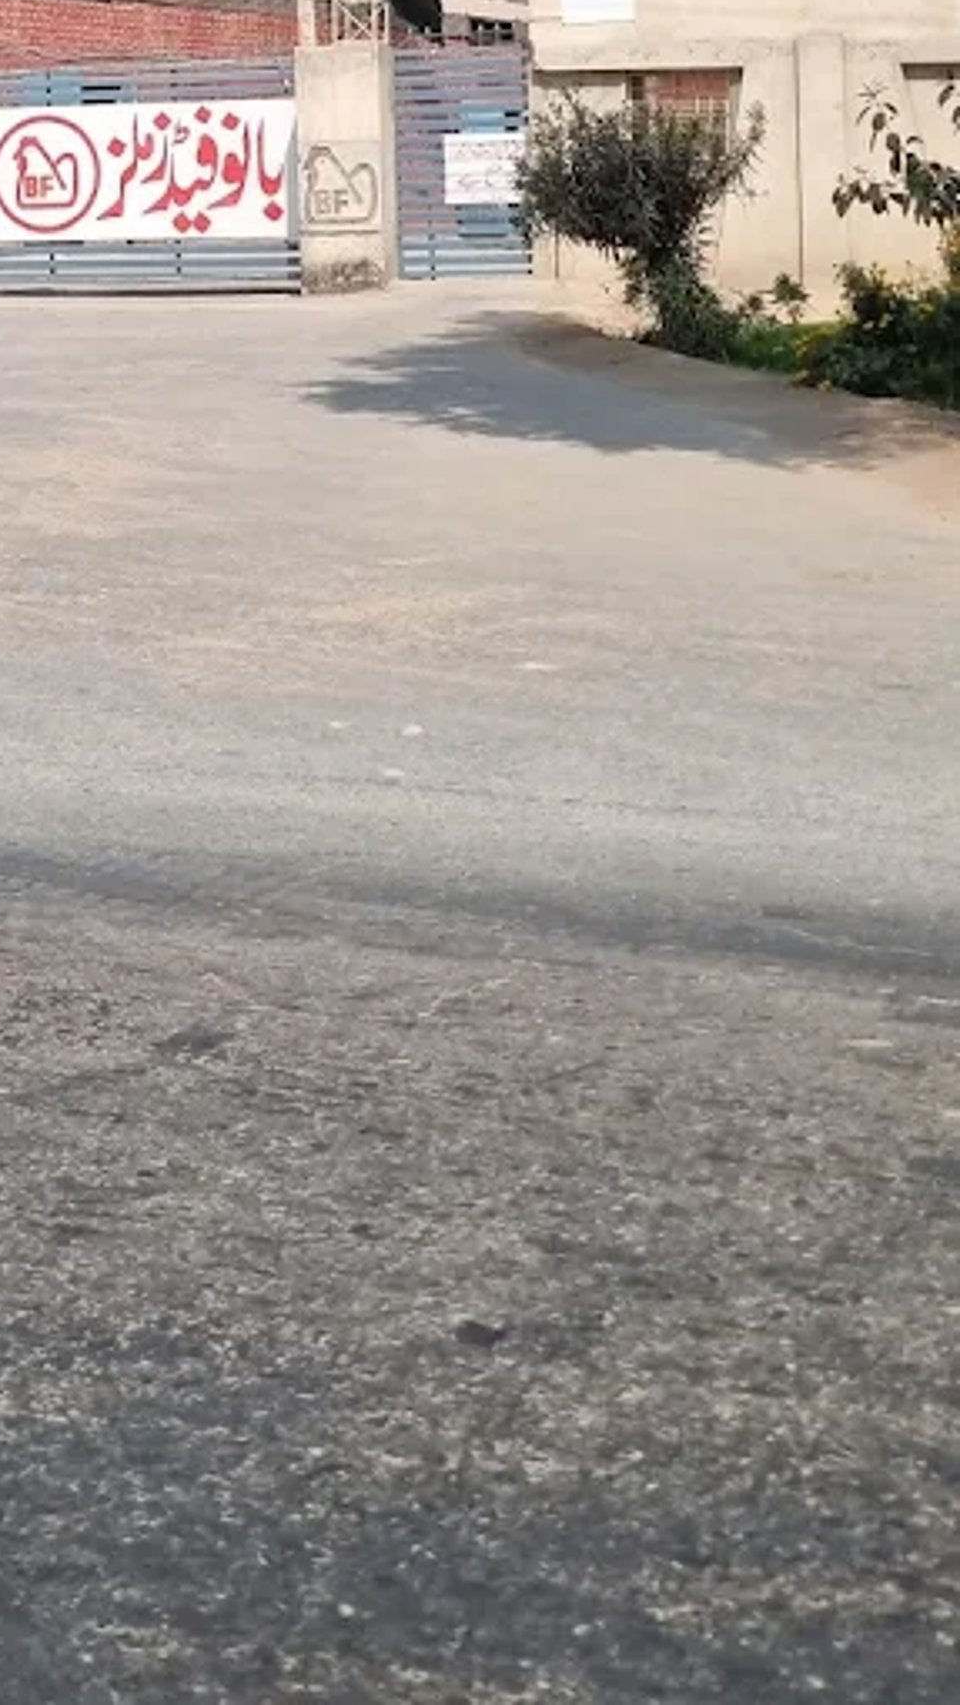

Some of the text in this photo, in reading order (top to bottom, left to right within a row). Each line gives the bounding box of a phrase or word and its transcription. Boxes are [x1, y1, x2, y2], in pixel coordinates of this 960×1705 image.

[206, 111, 286, 222] بانو
[25, 175, 54, 198] BF
[313, 189, 349, 215] BF
